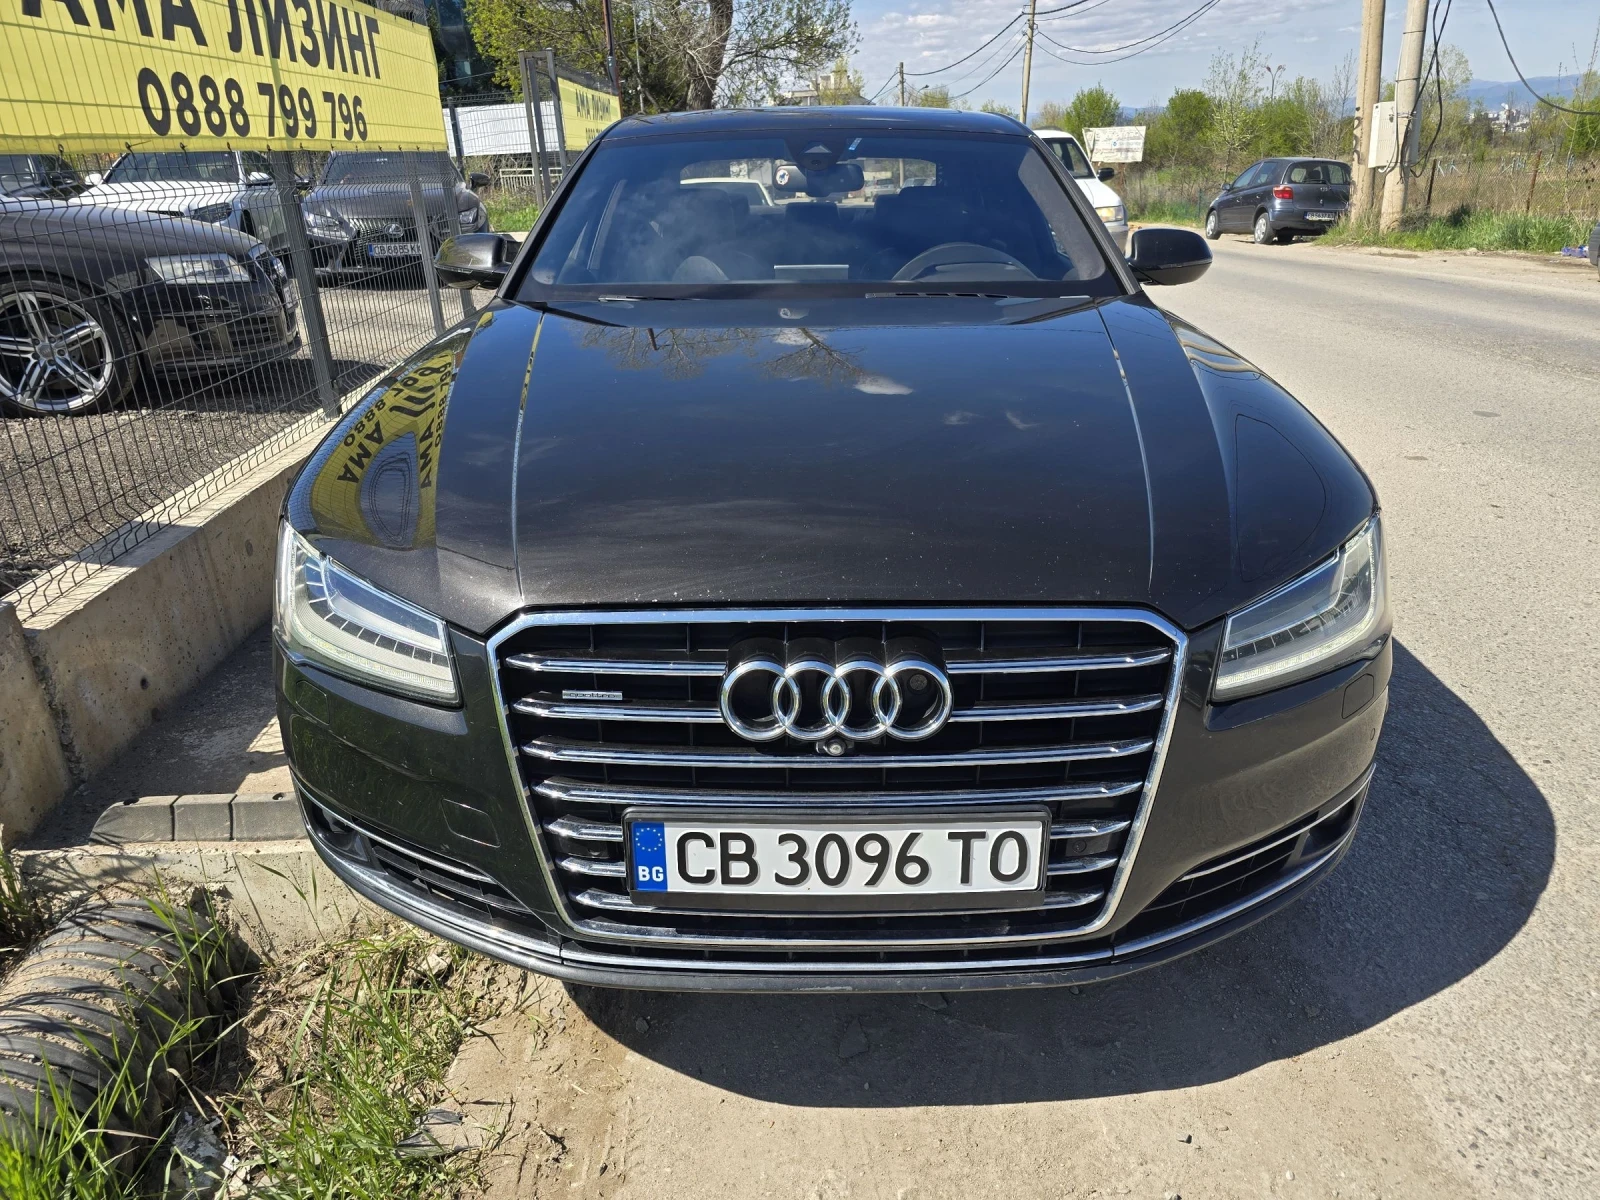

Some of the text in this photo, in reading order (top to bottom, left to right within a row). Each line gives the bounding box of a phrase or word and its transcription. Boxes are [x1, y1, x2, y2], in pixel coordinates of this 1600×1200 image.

[227, 0, 381, 80] ЛИЗИНГ
[137, 67, 368, 141] 0888 799 796
[568, 691, 617, 699] quattro
[637, 865, 664, 882] BG
[675, 830, 1028, 886] CB 3096 TO
